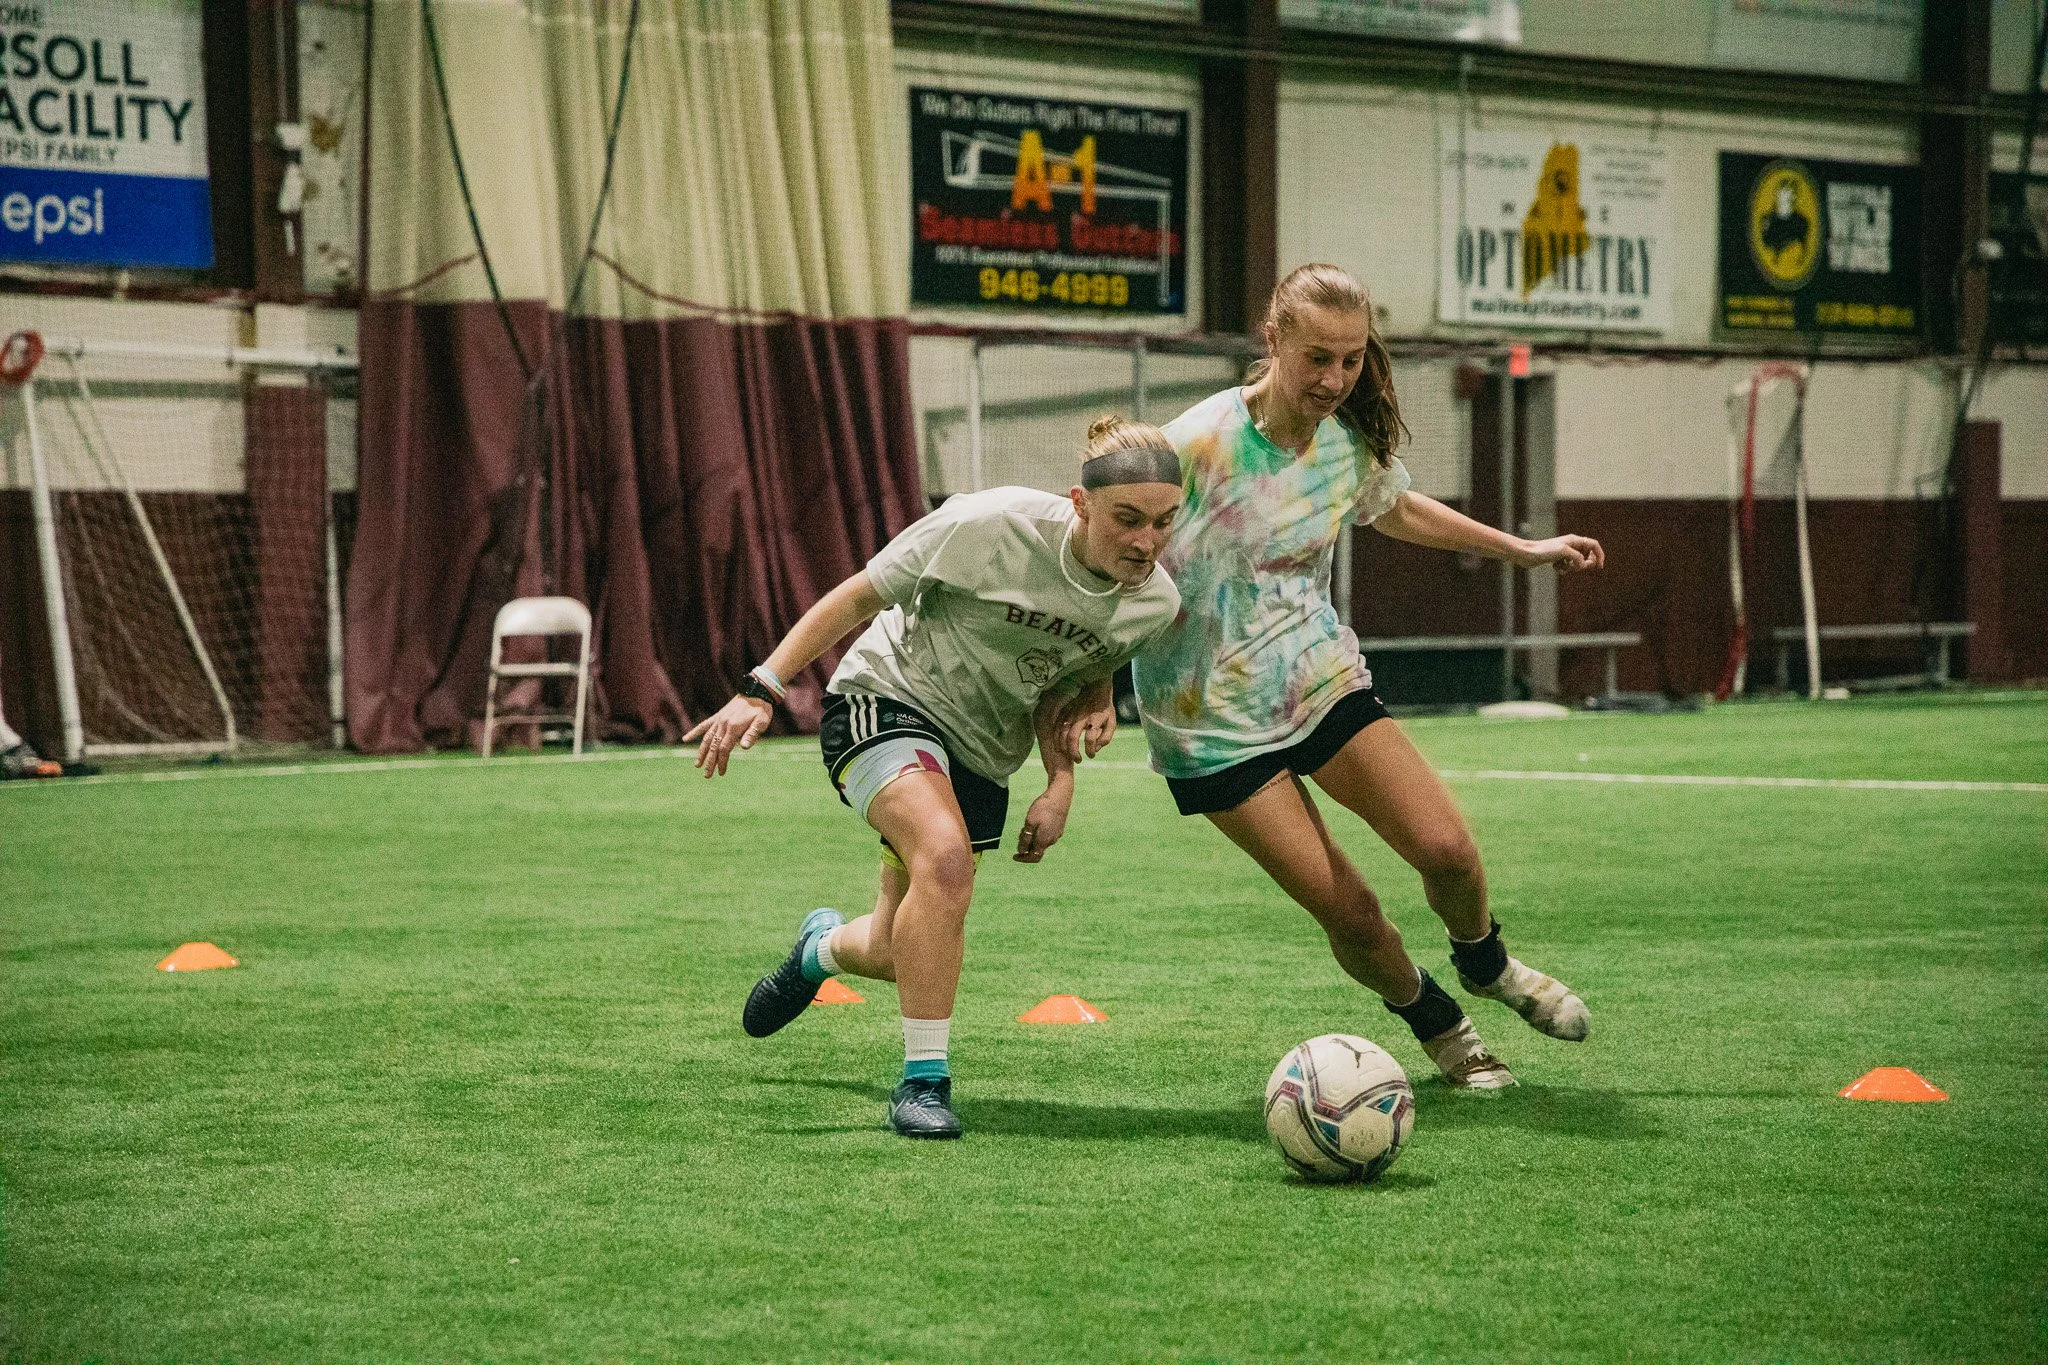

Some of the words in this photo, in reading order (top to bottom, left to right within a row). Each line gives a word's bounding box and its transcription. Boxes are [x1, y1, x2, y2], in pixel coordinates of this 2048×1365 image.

[0, 32, 150, 87] SOLL
[2, 187, 104, 245] epsi
[979, 266, 1130, 306] 946-4999
